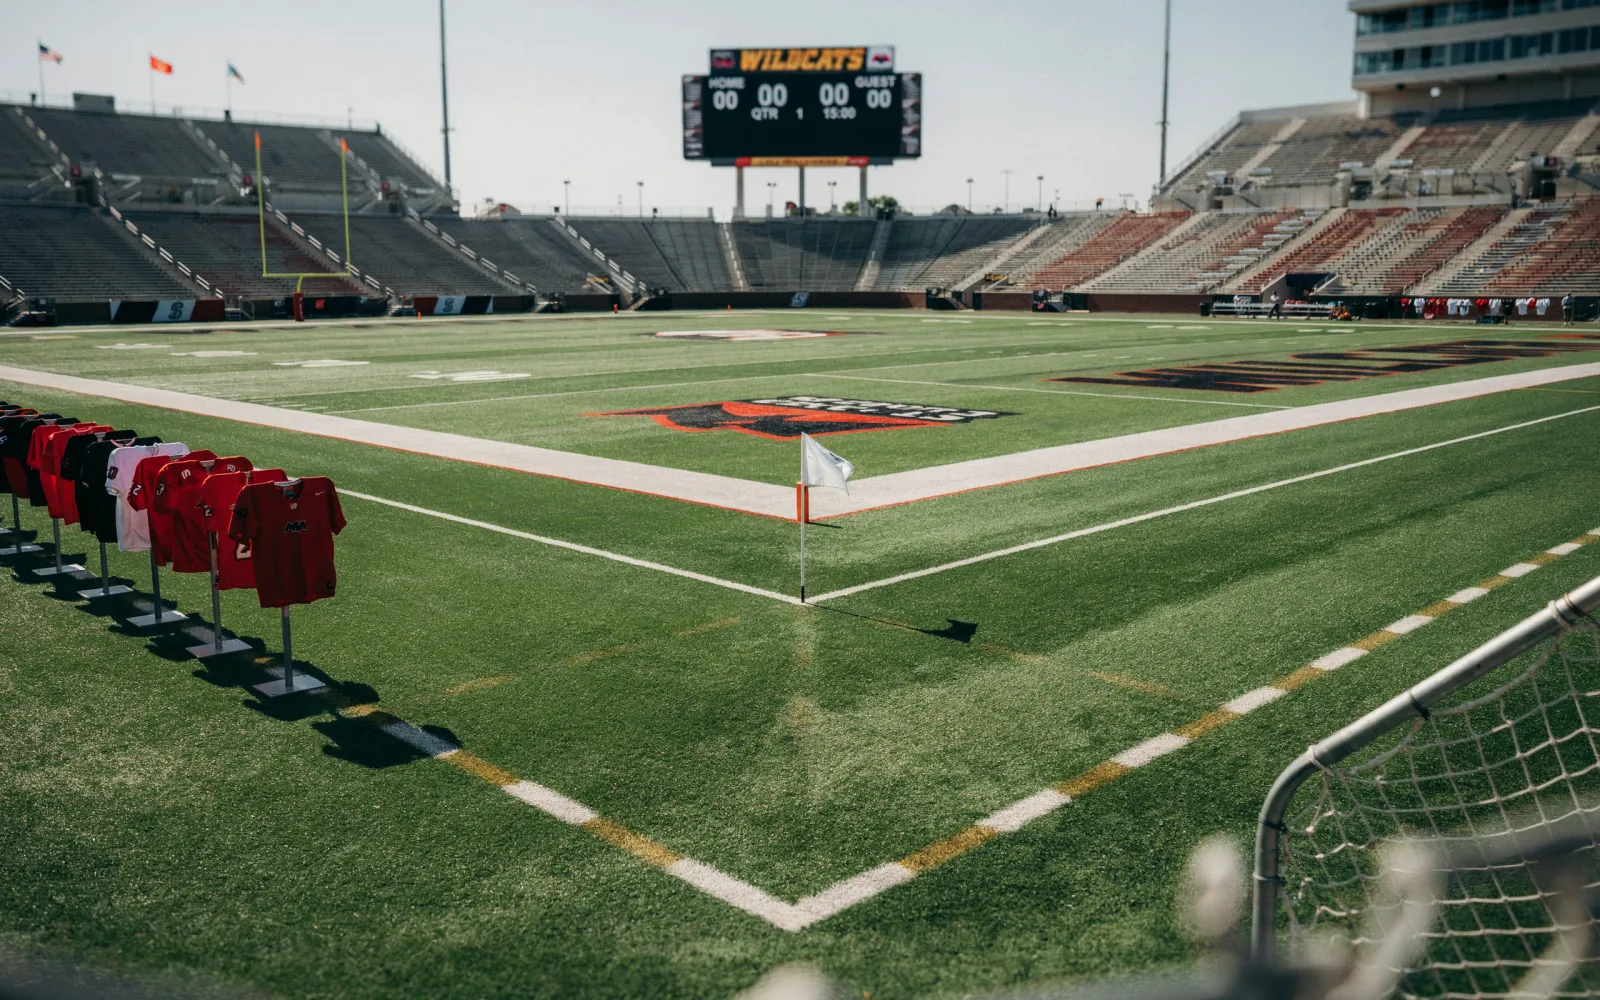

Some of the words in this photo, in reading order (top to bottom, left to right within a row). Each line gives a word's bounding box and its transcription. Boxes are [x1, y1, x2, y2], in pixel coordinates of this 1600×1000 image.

[740, 48, 865, 72] WILDCATS
[708, 77, 745, 89] HOME
[855, 76, 897, 88] GUEST
[712, 90, 739, 110] 00
[757, 83, 788, 107] 00
[819, 82, 850, 107] 00
[866, 89, 892, 109] 00
[750, 107, 779, 121] QTR
[795, 107, 804, 120] 1
[822, 107, 856, 120] 15:00
